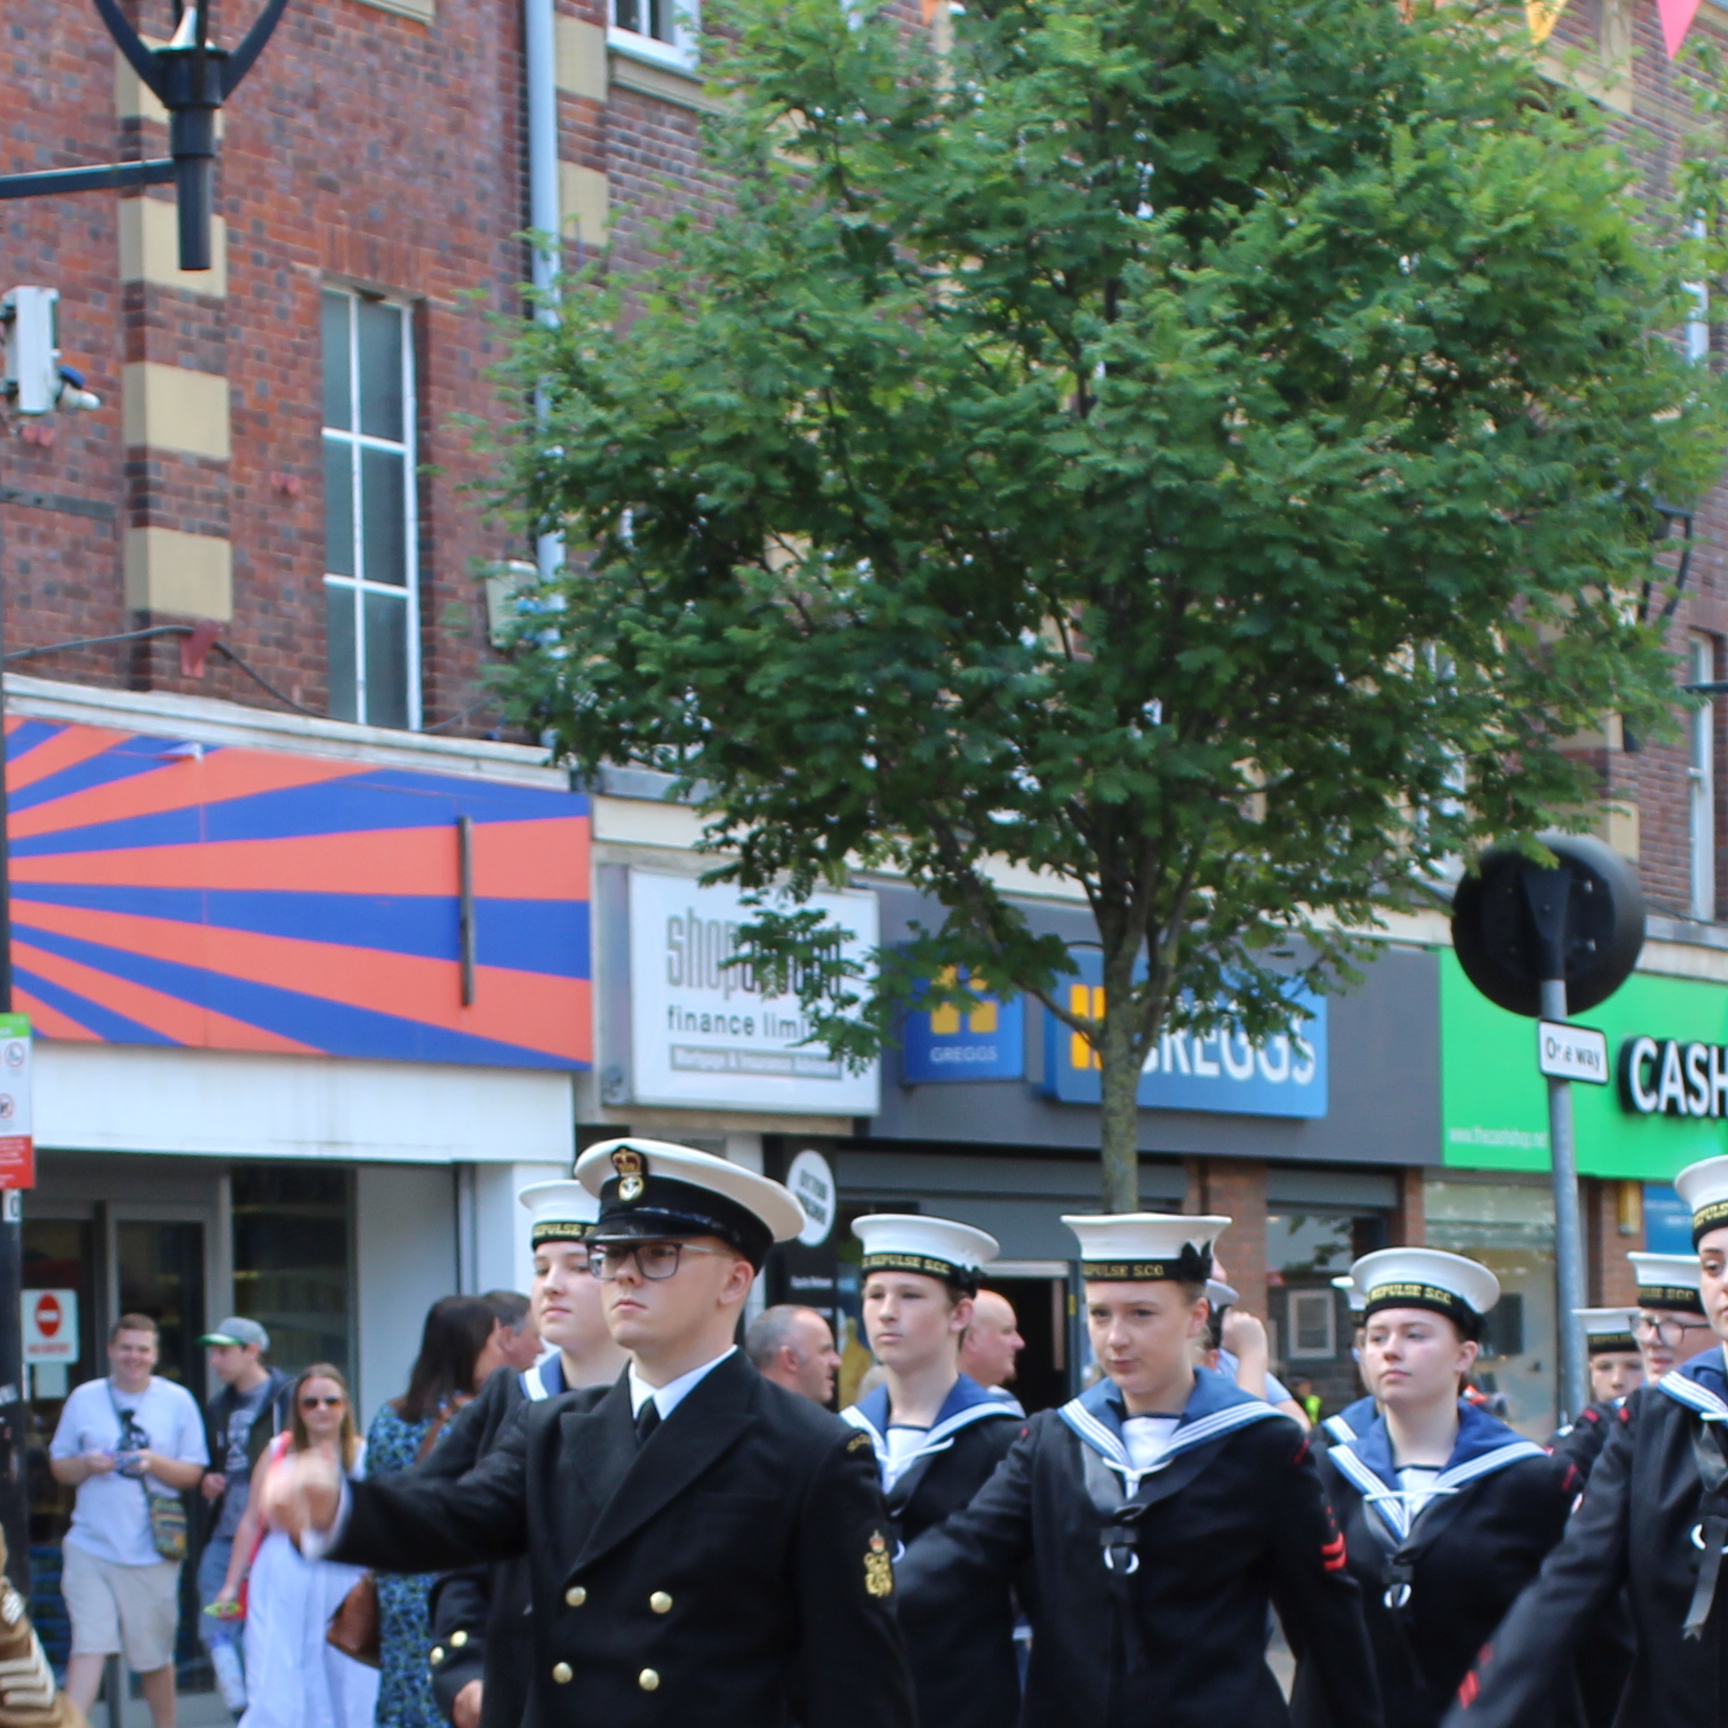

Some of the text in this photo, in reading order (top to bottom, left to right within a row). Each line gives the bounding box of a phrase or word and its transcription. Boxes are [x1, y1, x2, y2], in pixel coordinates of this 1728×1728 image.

[668, 1004, 754, 1036] finance
[1136, 992, 1316, 1085] REGGS
[930, 1046, 997, 1064] GREGGS
[1575, 1048, 1602, 1072] way
